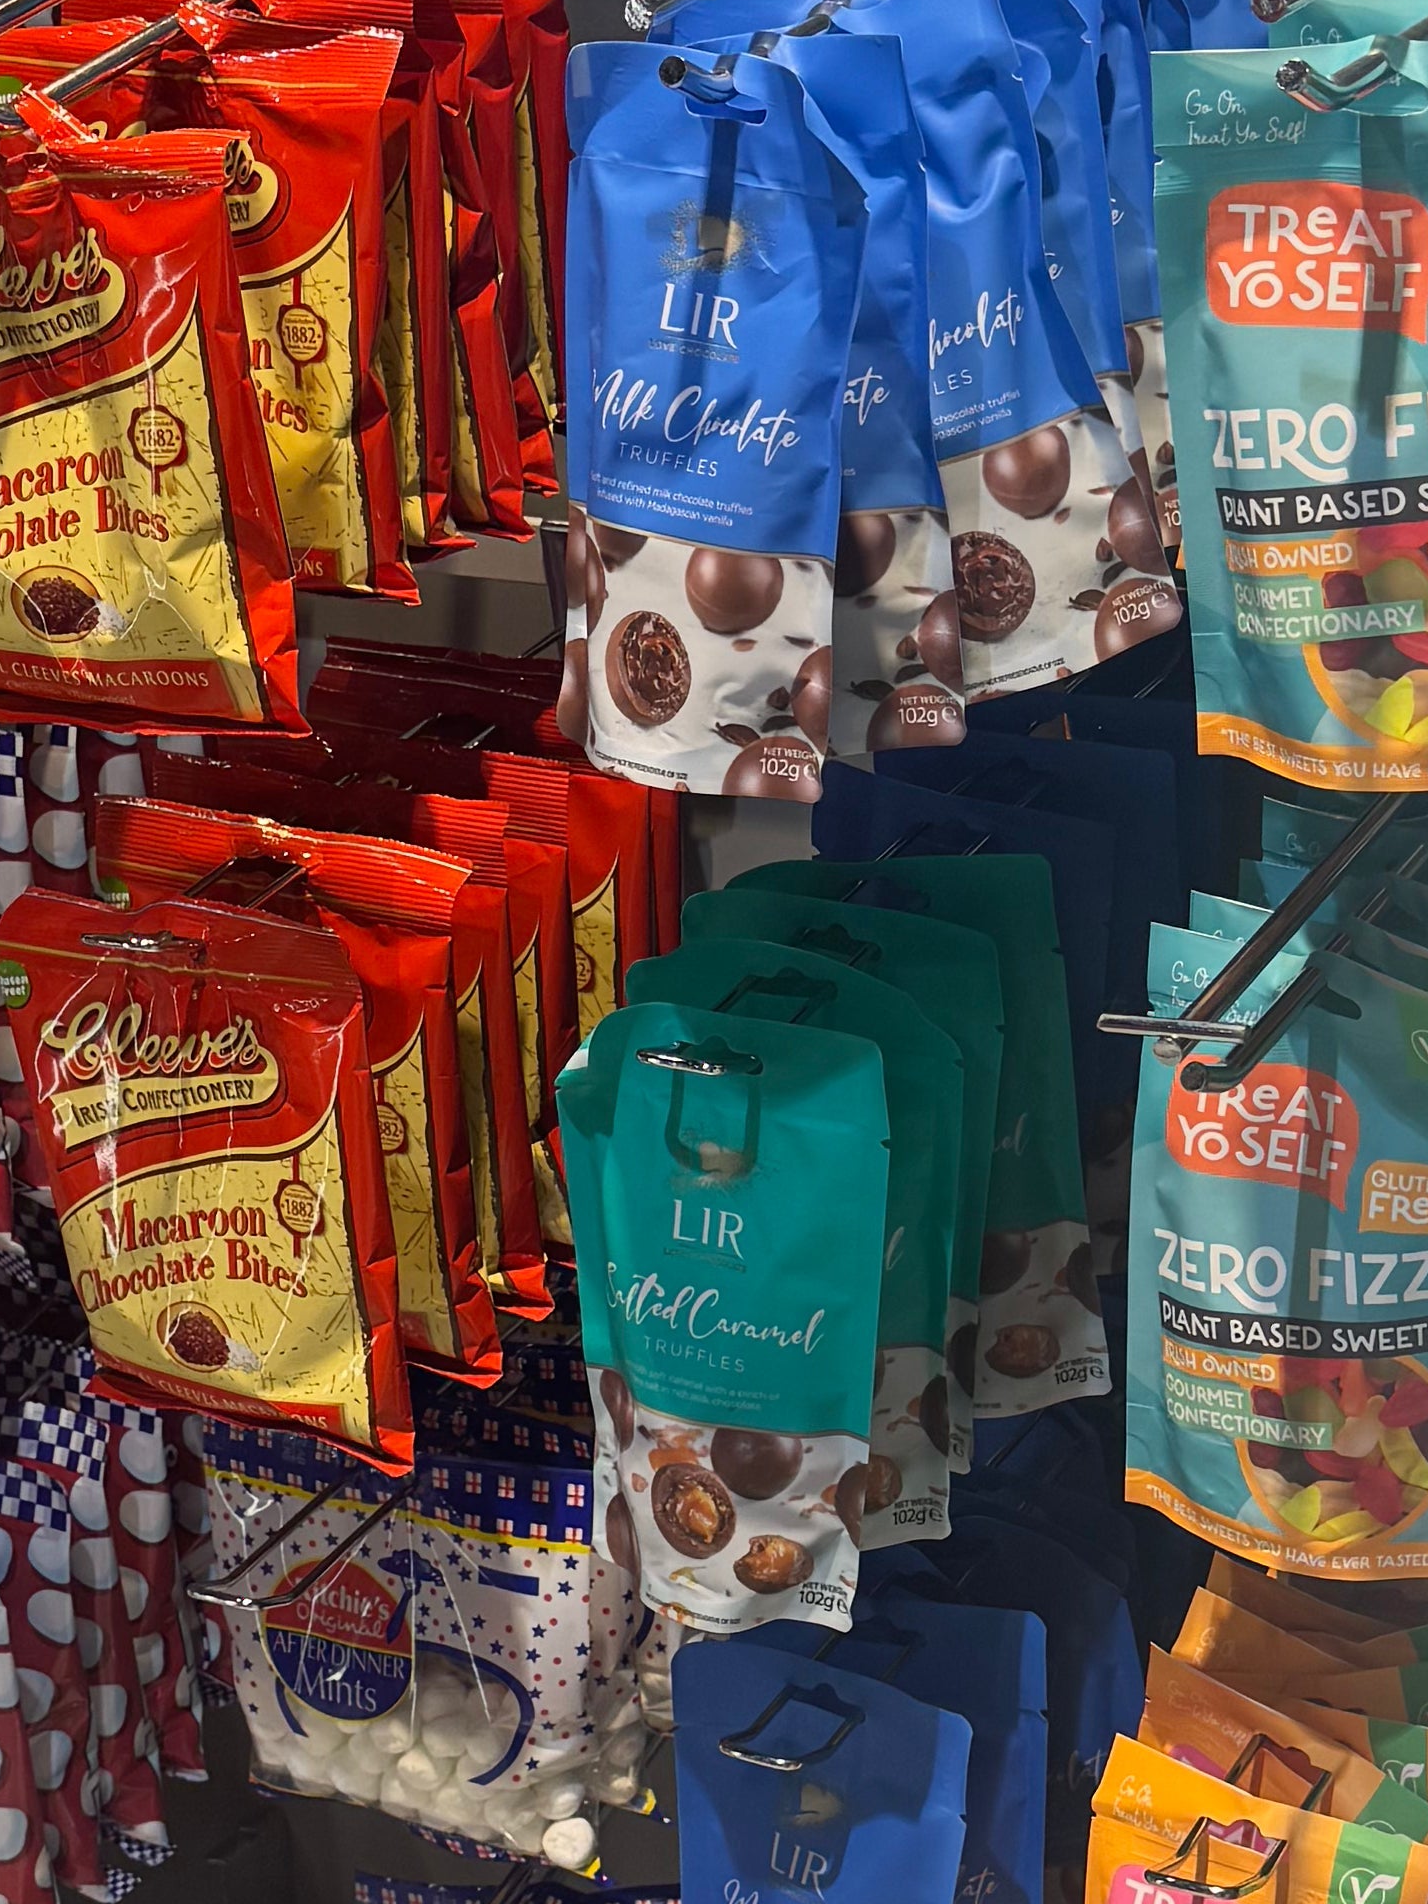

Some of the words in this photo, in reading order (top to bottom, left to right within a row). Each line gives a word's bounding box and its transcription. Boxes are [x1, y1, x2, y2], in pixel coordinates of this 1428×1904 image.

[1187, 121, 1231, 146] Treat
[1290, 260, 1422, 313] SELF
[659, 282, 740, 350] LIR
[593, 369, 658, 431] Milk
[664, 385, 801, 466] Chocolate
[138, 428, 175, 448] 1882
[1204, 403, 1356, 480] ZERO
[619, 442, 719, 478] TRUFFLES
[94, 485, 169, 543] Bites
[672, 491, 714, 510] chocolate
[716, 499, 753, 516] truffles
[1222, 494, 1287, 528] PLANT
[1296, 484, 1406, 521] BASED
[1263, 542, 1353, 568] OWNED
[1112, 602, 1152, 628] 102g
[1234, 585, 1313, 611] GOURMET
[1236, 603, 1415, 638] CONFECTIONARY
[84, 666, 209, 688] MACAROONS
[1334, 756, 1366, 777] YOU
[672, 1199, 744, 1259] LIR
[689, 1285, 826, 1356] Caramel
